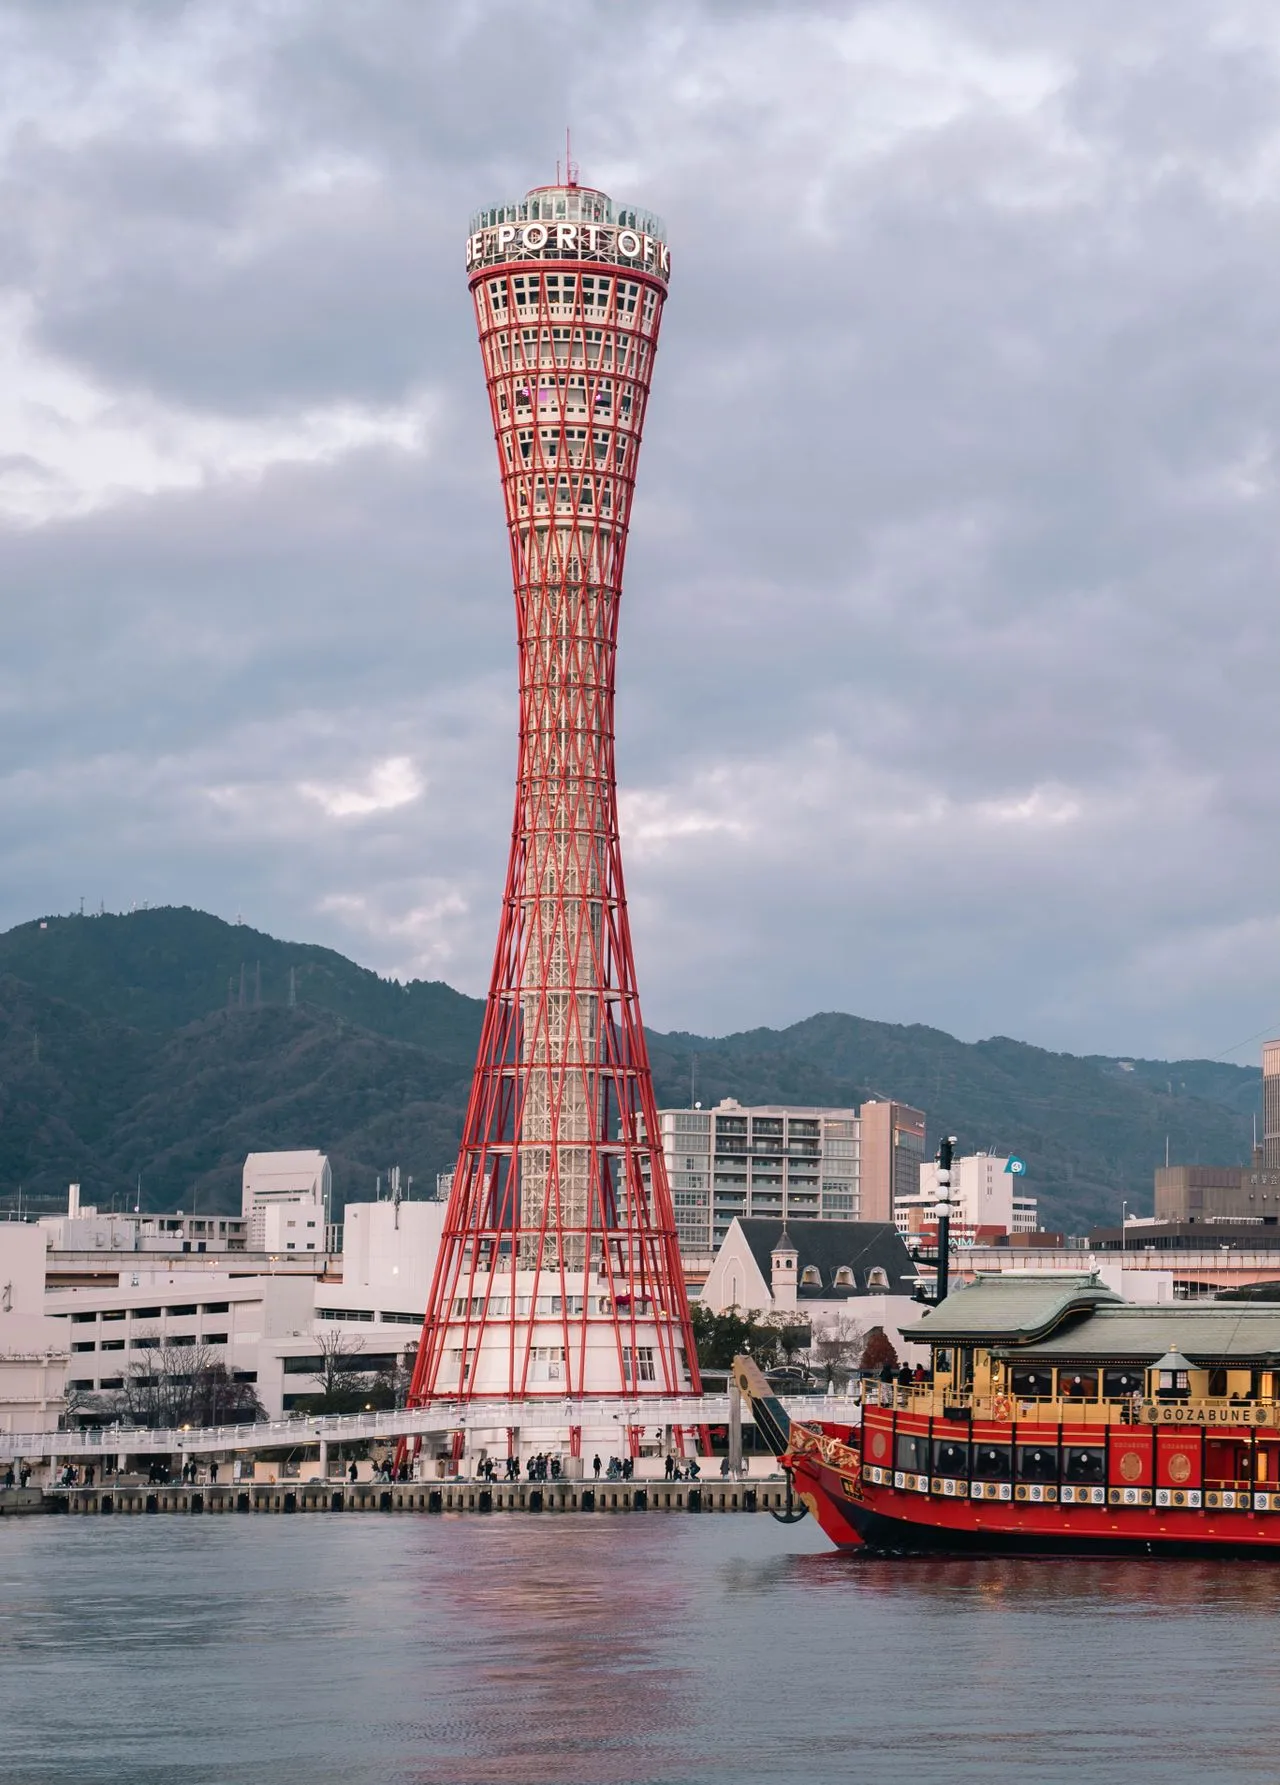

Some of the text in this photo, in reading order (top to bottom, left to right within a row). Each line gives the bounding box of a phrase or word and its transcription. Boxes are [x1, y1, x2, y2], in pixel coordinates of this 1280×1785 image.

[498, 223, 600, 252] PORT
[617, 230, 653, 261] OF
[1163, 1408, 1250, 1421] GOZABUNE
